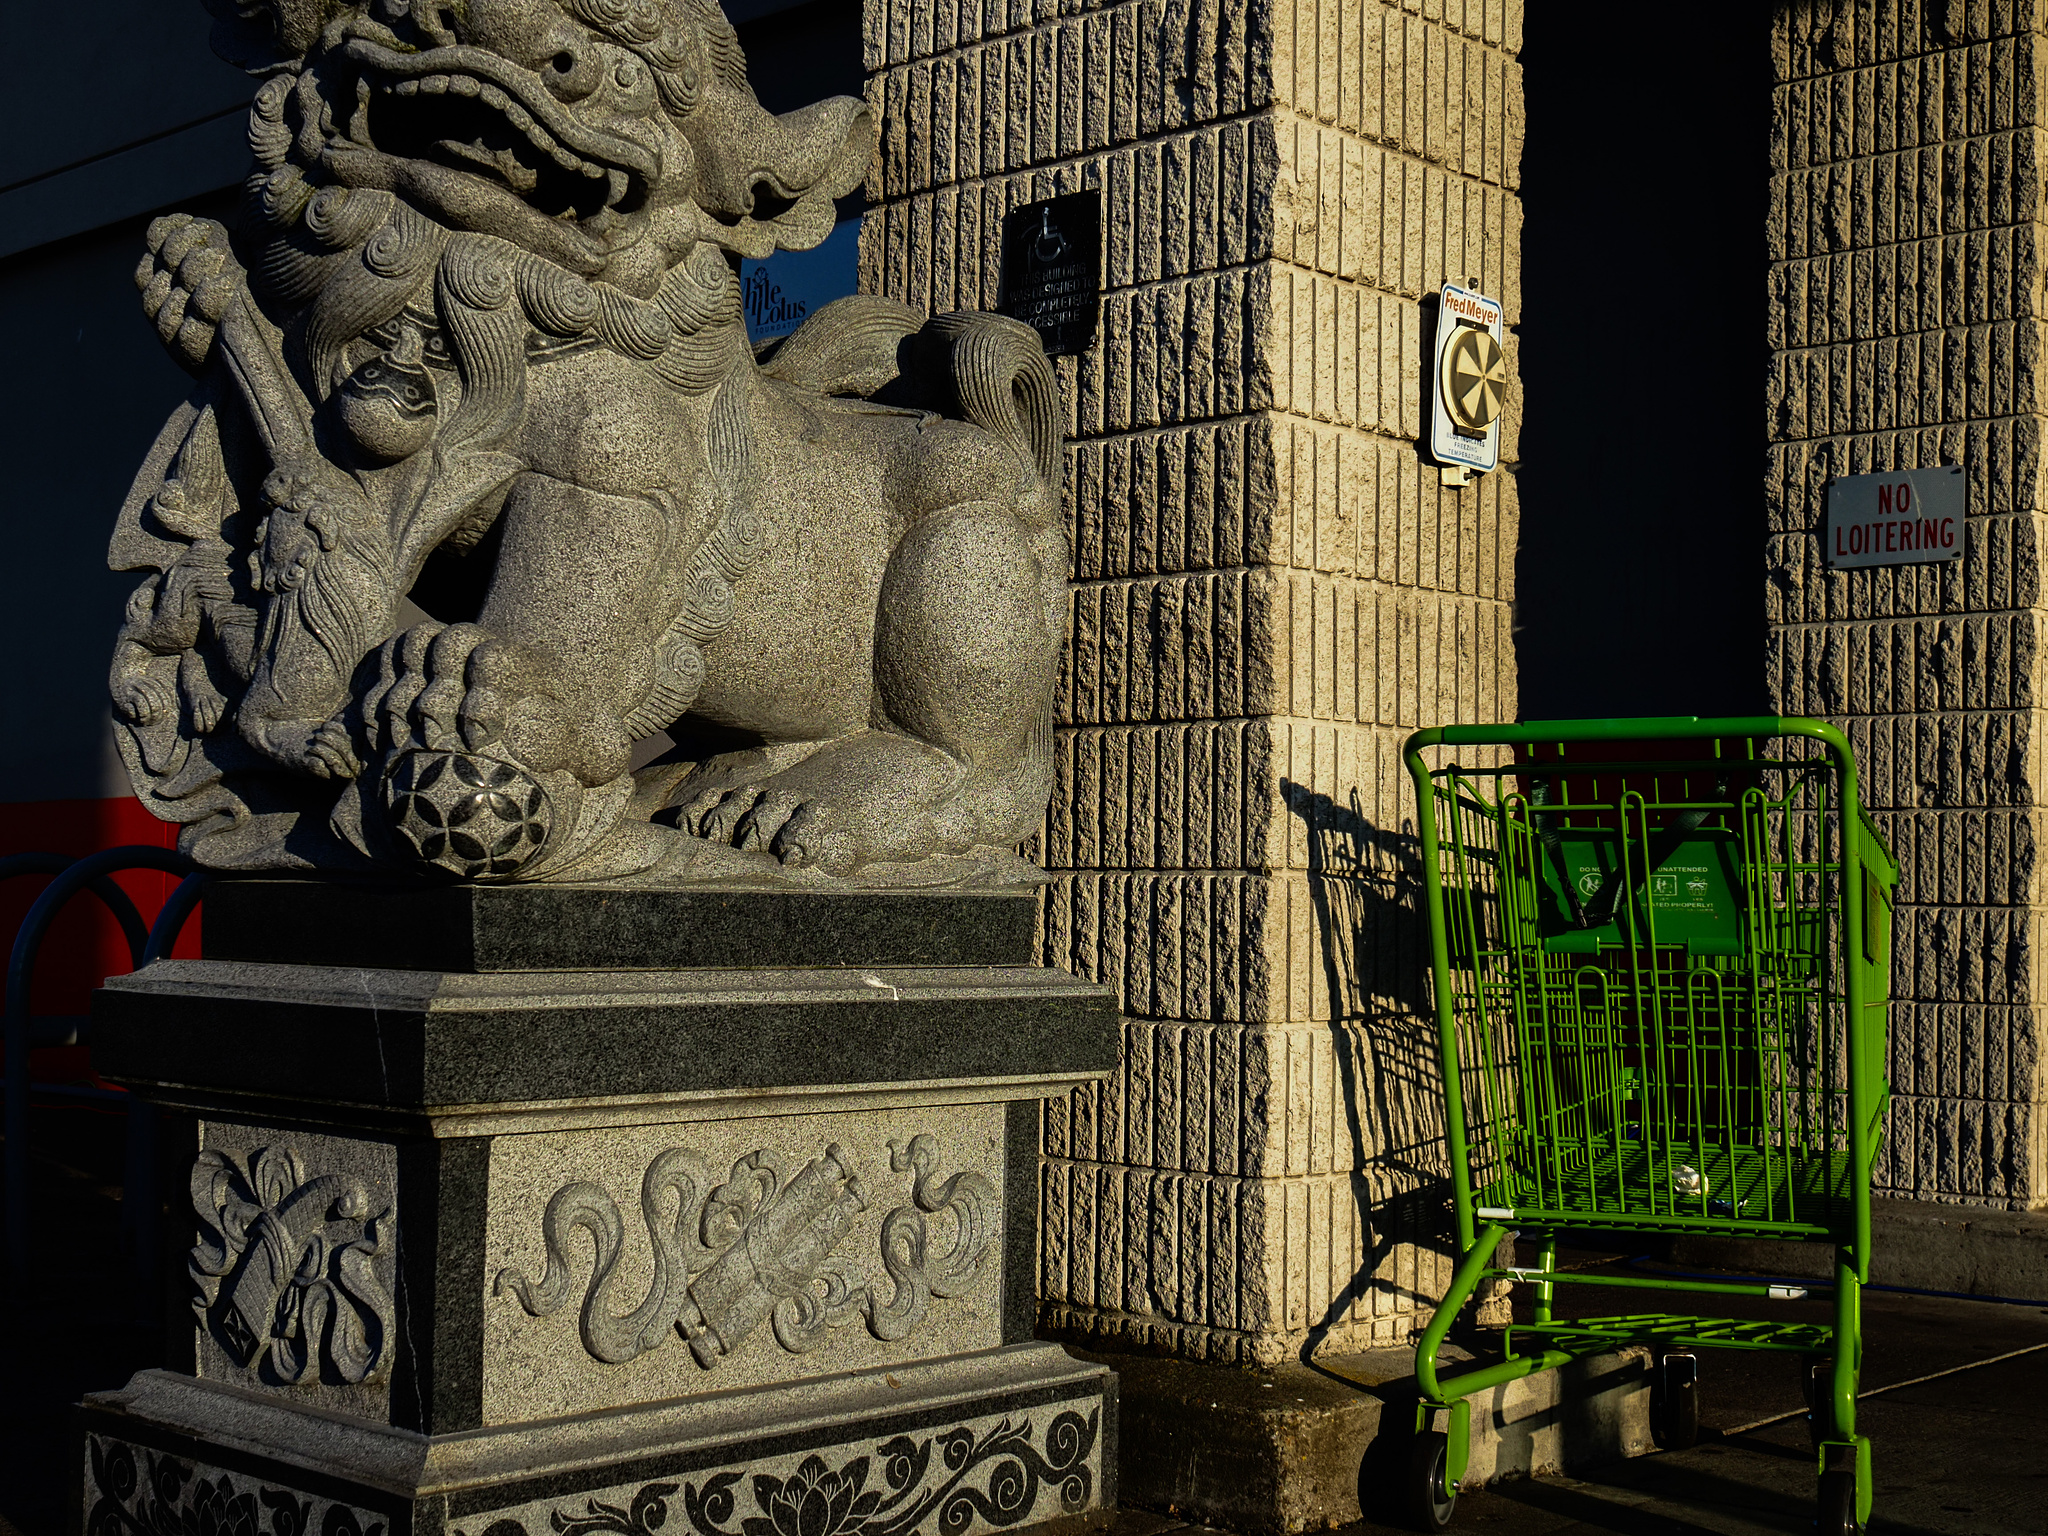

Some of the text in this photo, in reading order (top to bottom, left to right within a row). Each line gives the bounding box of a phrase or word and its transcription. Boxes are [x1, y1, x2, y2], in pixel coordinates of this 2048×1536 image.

[1019, 262, 1087, 287] THIS BUILDING
[742, 277, 781, 316] hite
[1009, 275, 1096, 304] WAS DESIGNED TO
[756, 297, 806, 326] Lotus
[1014, 303, 1028, 318] BE
[1445, 291, 1498, 324] Fred Meyer
[1448, 448, 1482, 462] TEMPERATURE
[1878, 483, 1911, 515] NO
[1836, 517, 1954, 556] LOITERING
